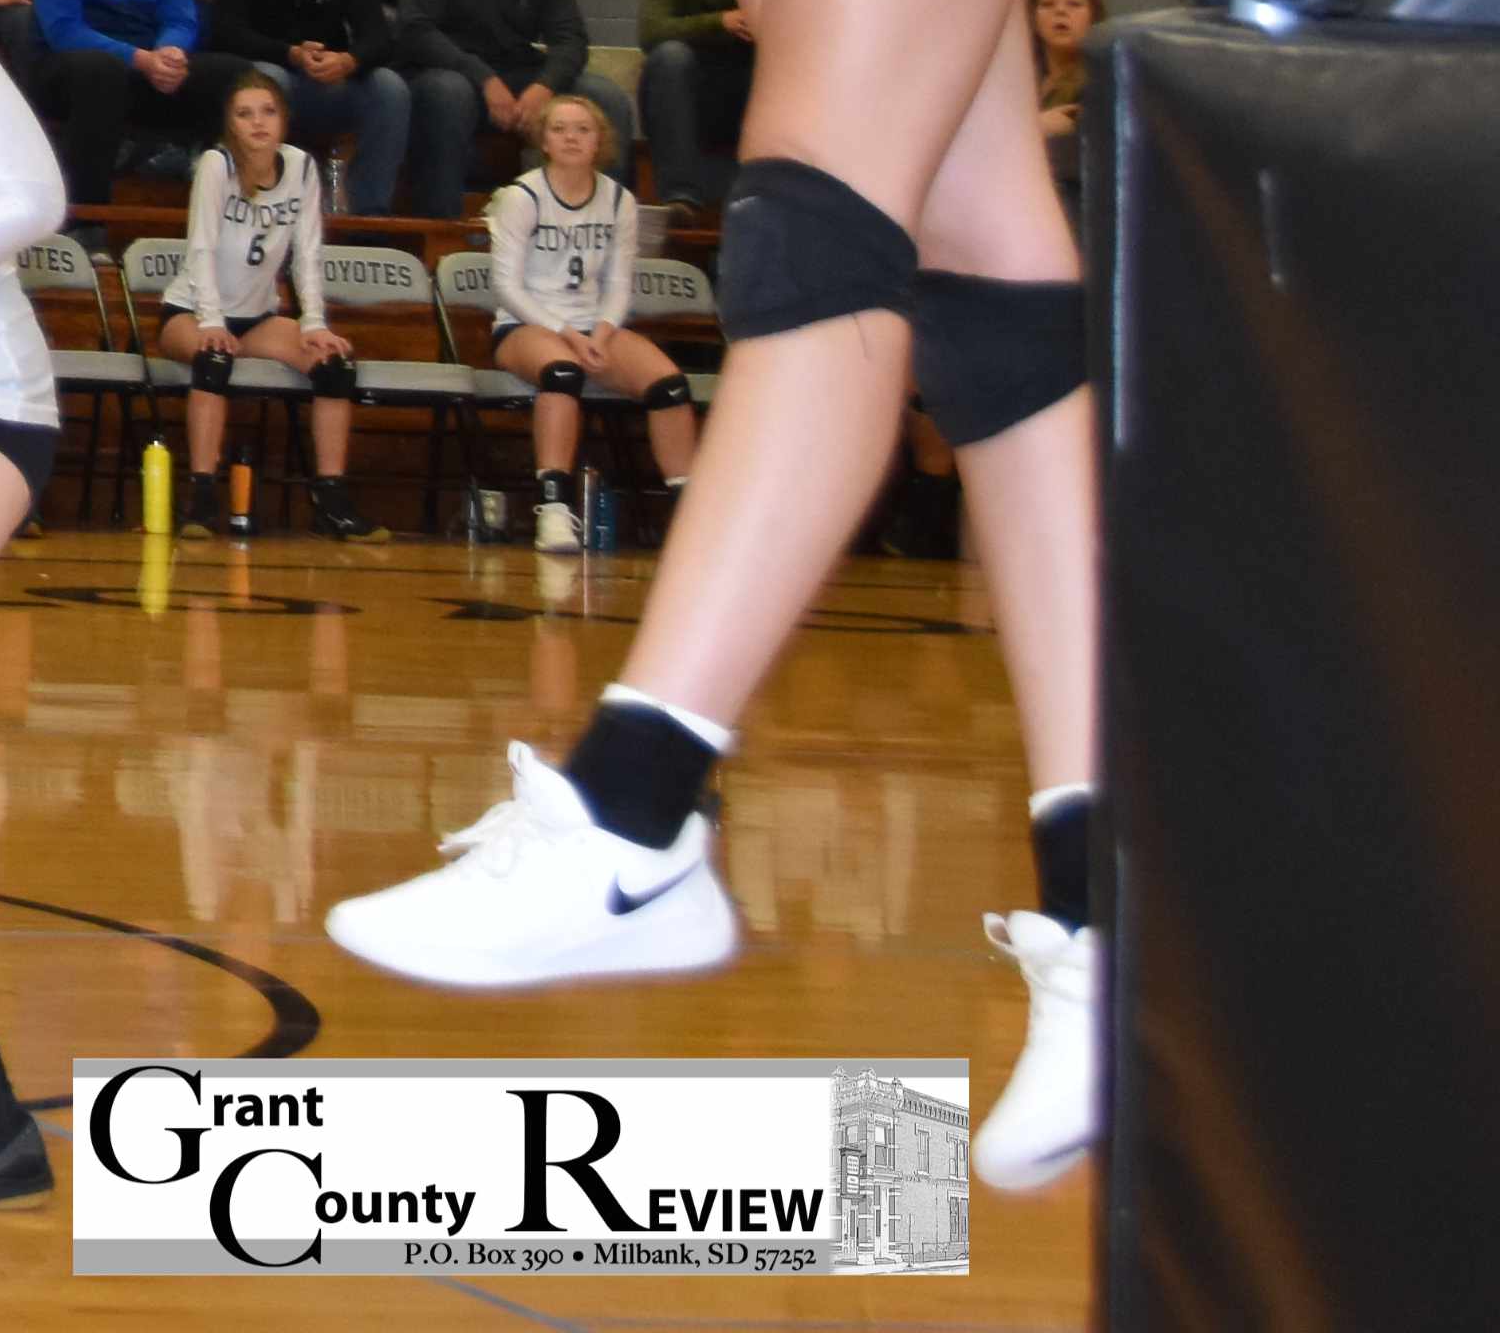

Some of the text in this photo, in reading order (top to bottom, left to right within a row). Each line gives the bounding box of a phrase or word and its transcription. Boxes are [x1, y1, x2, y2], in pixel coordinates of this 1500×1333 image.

[142, 253, 186, 278] COY
[245, 234, 266, 266] 6
[564, 255, 584, 290] 9
